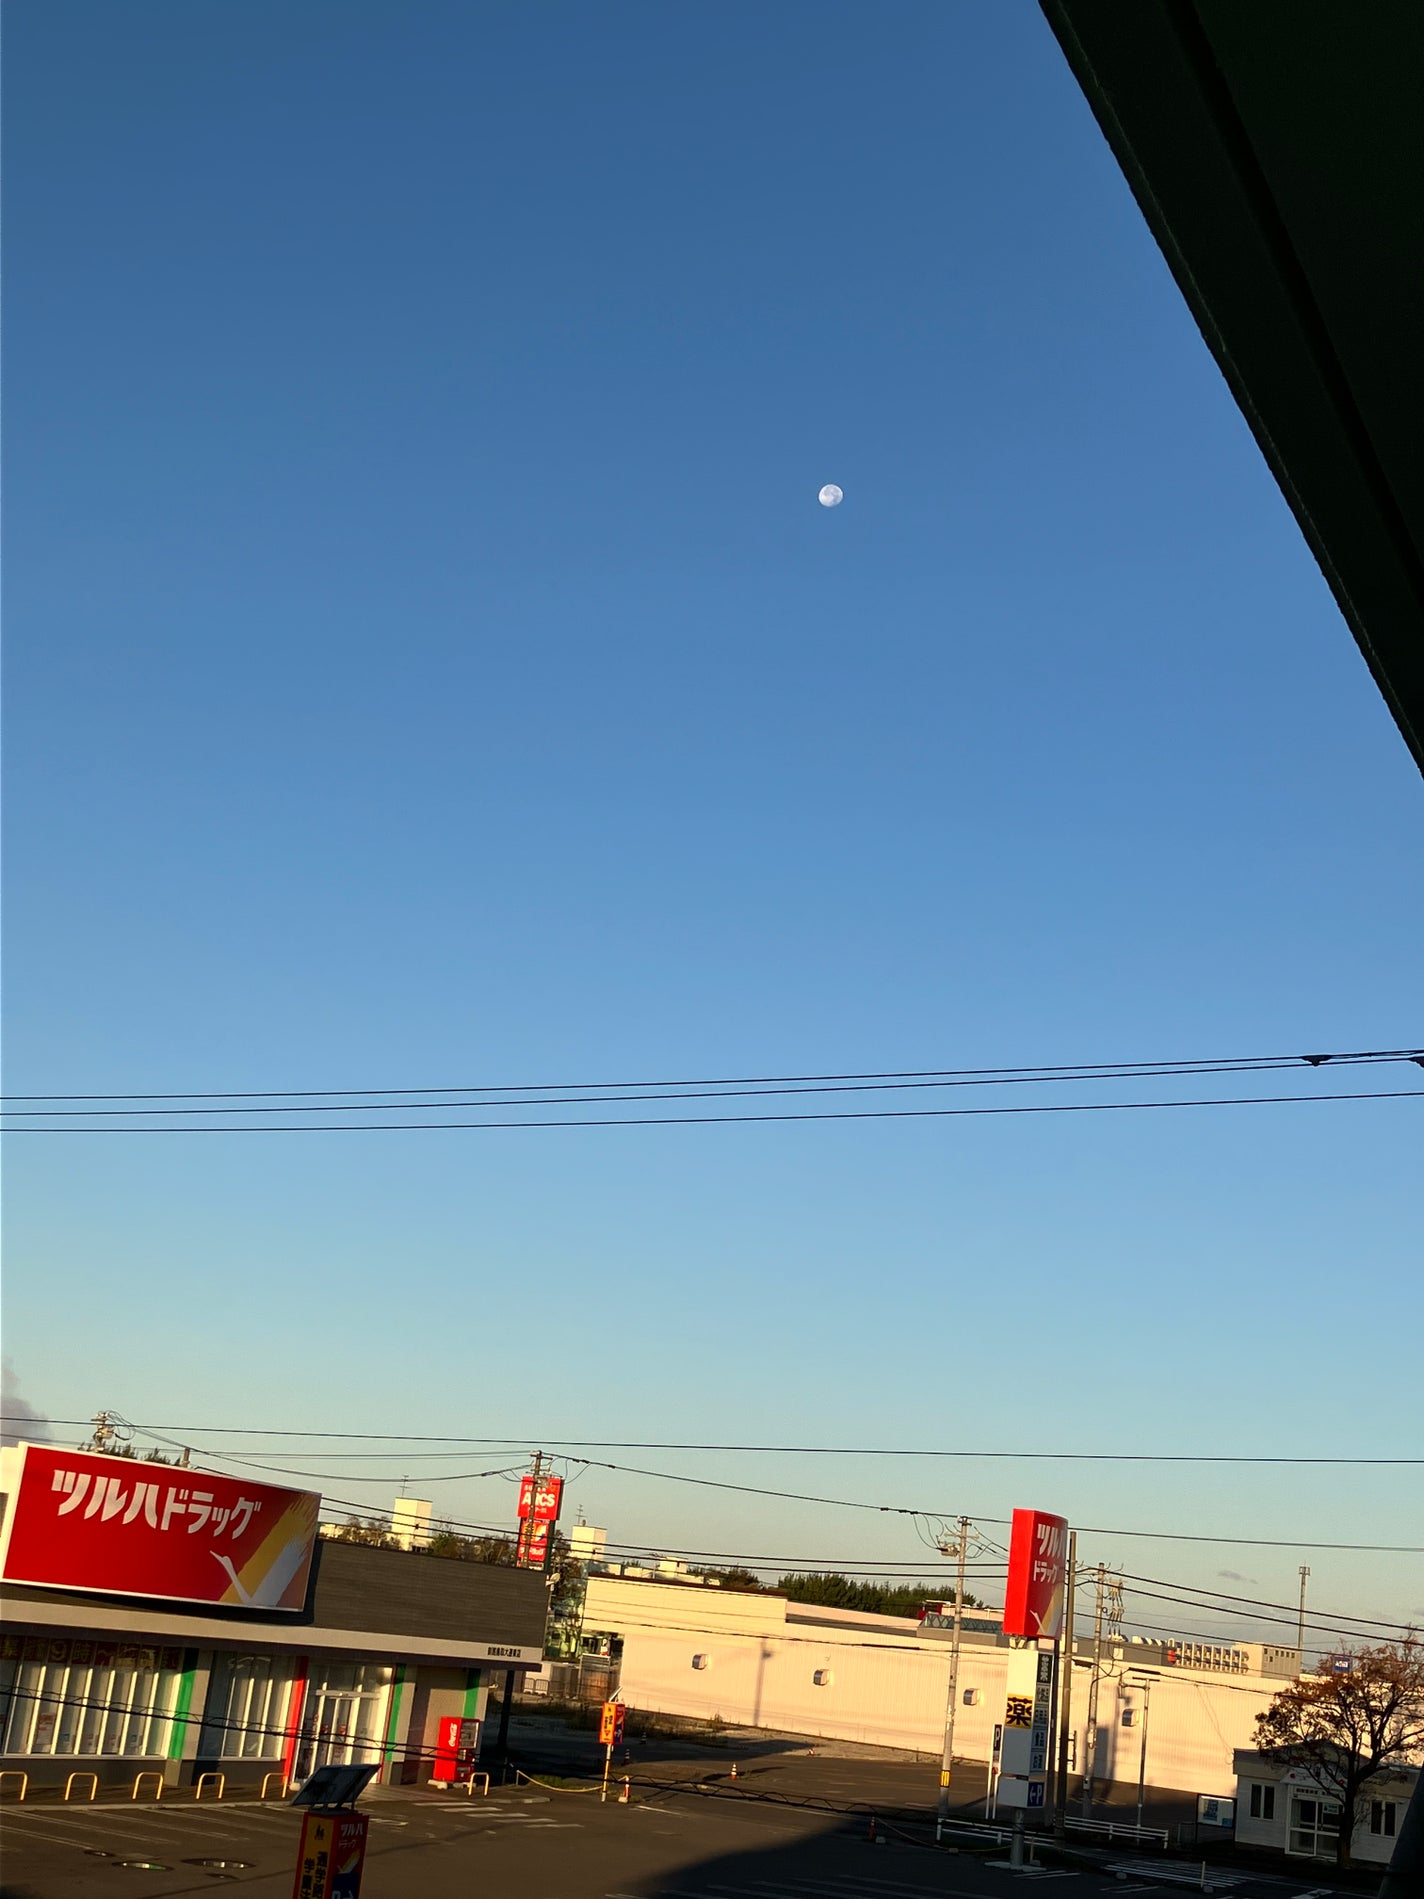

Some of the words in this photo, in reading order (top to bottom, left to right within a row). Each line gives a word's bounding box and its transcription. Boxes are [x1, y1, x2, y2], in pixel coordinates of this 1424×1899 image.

[51, 1469, 262, 1540] ツルハドラッグ
[1006, 1696, 1033, 1727] 薬
